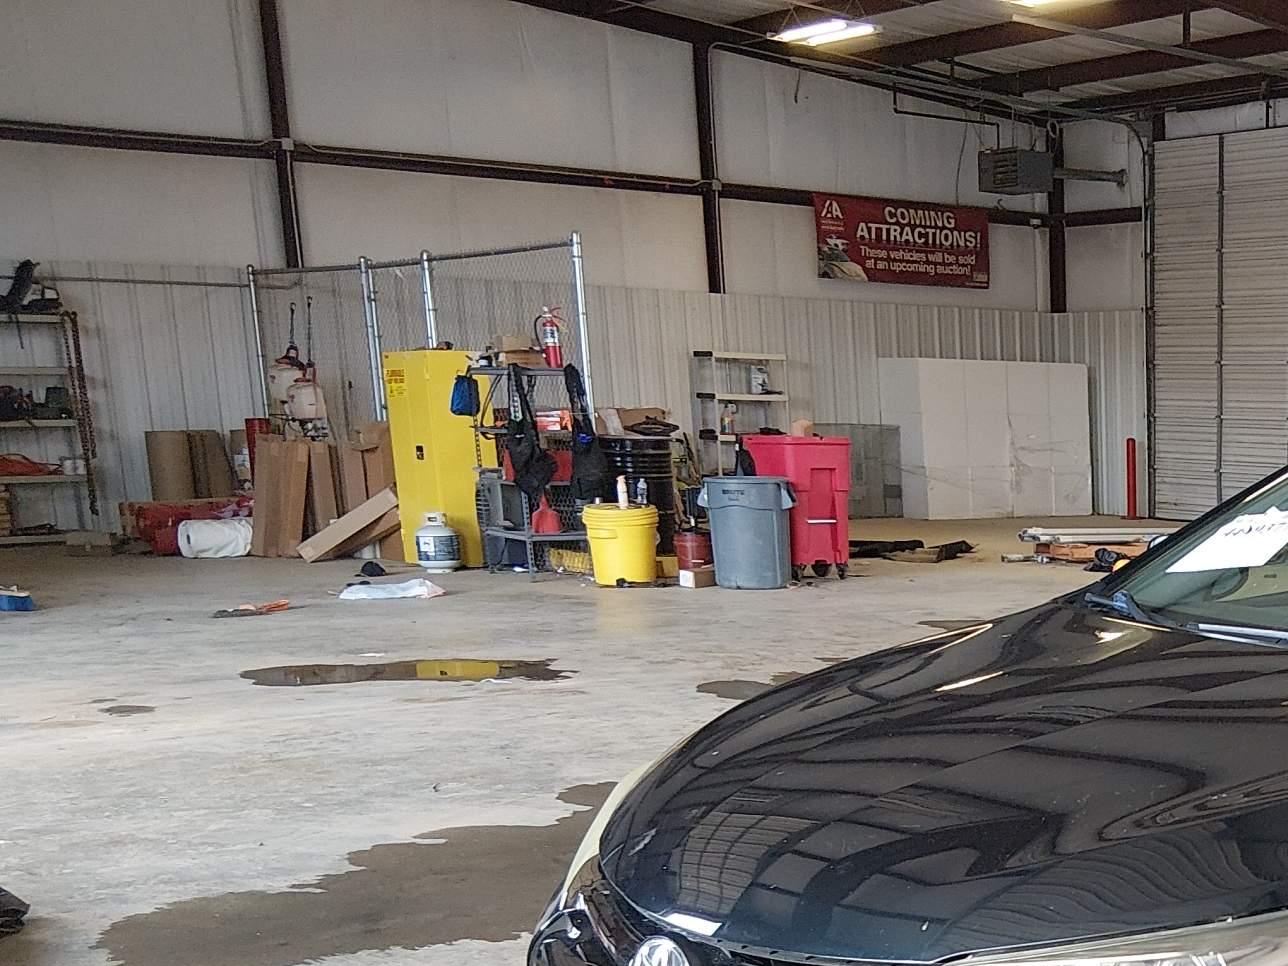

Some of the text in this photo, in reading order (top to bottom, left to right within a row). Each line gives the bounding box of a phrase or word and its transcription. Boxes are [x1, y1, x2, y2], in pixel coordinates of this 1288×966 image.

[884, 206, 955, 229] COMING
[856, 222, 981, 248] ATTRACTIONS!
[860, 246, 976, 265] These vehicles will be sold
[865, 258, 971, 276] at an upcoming auction!
